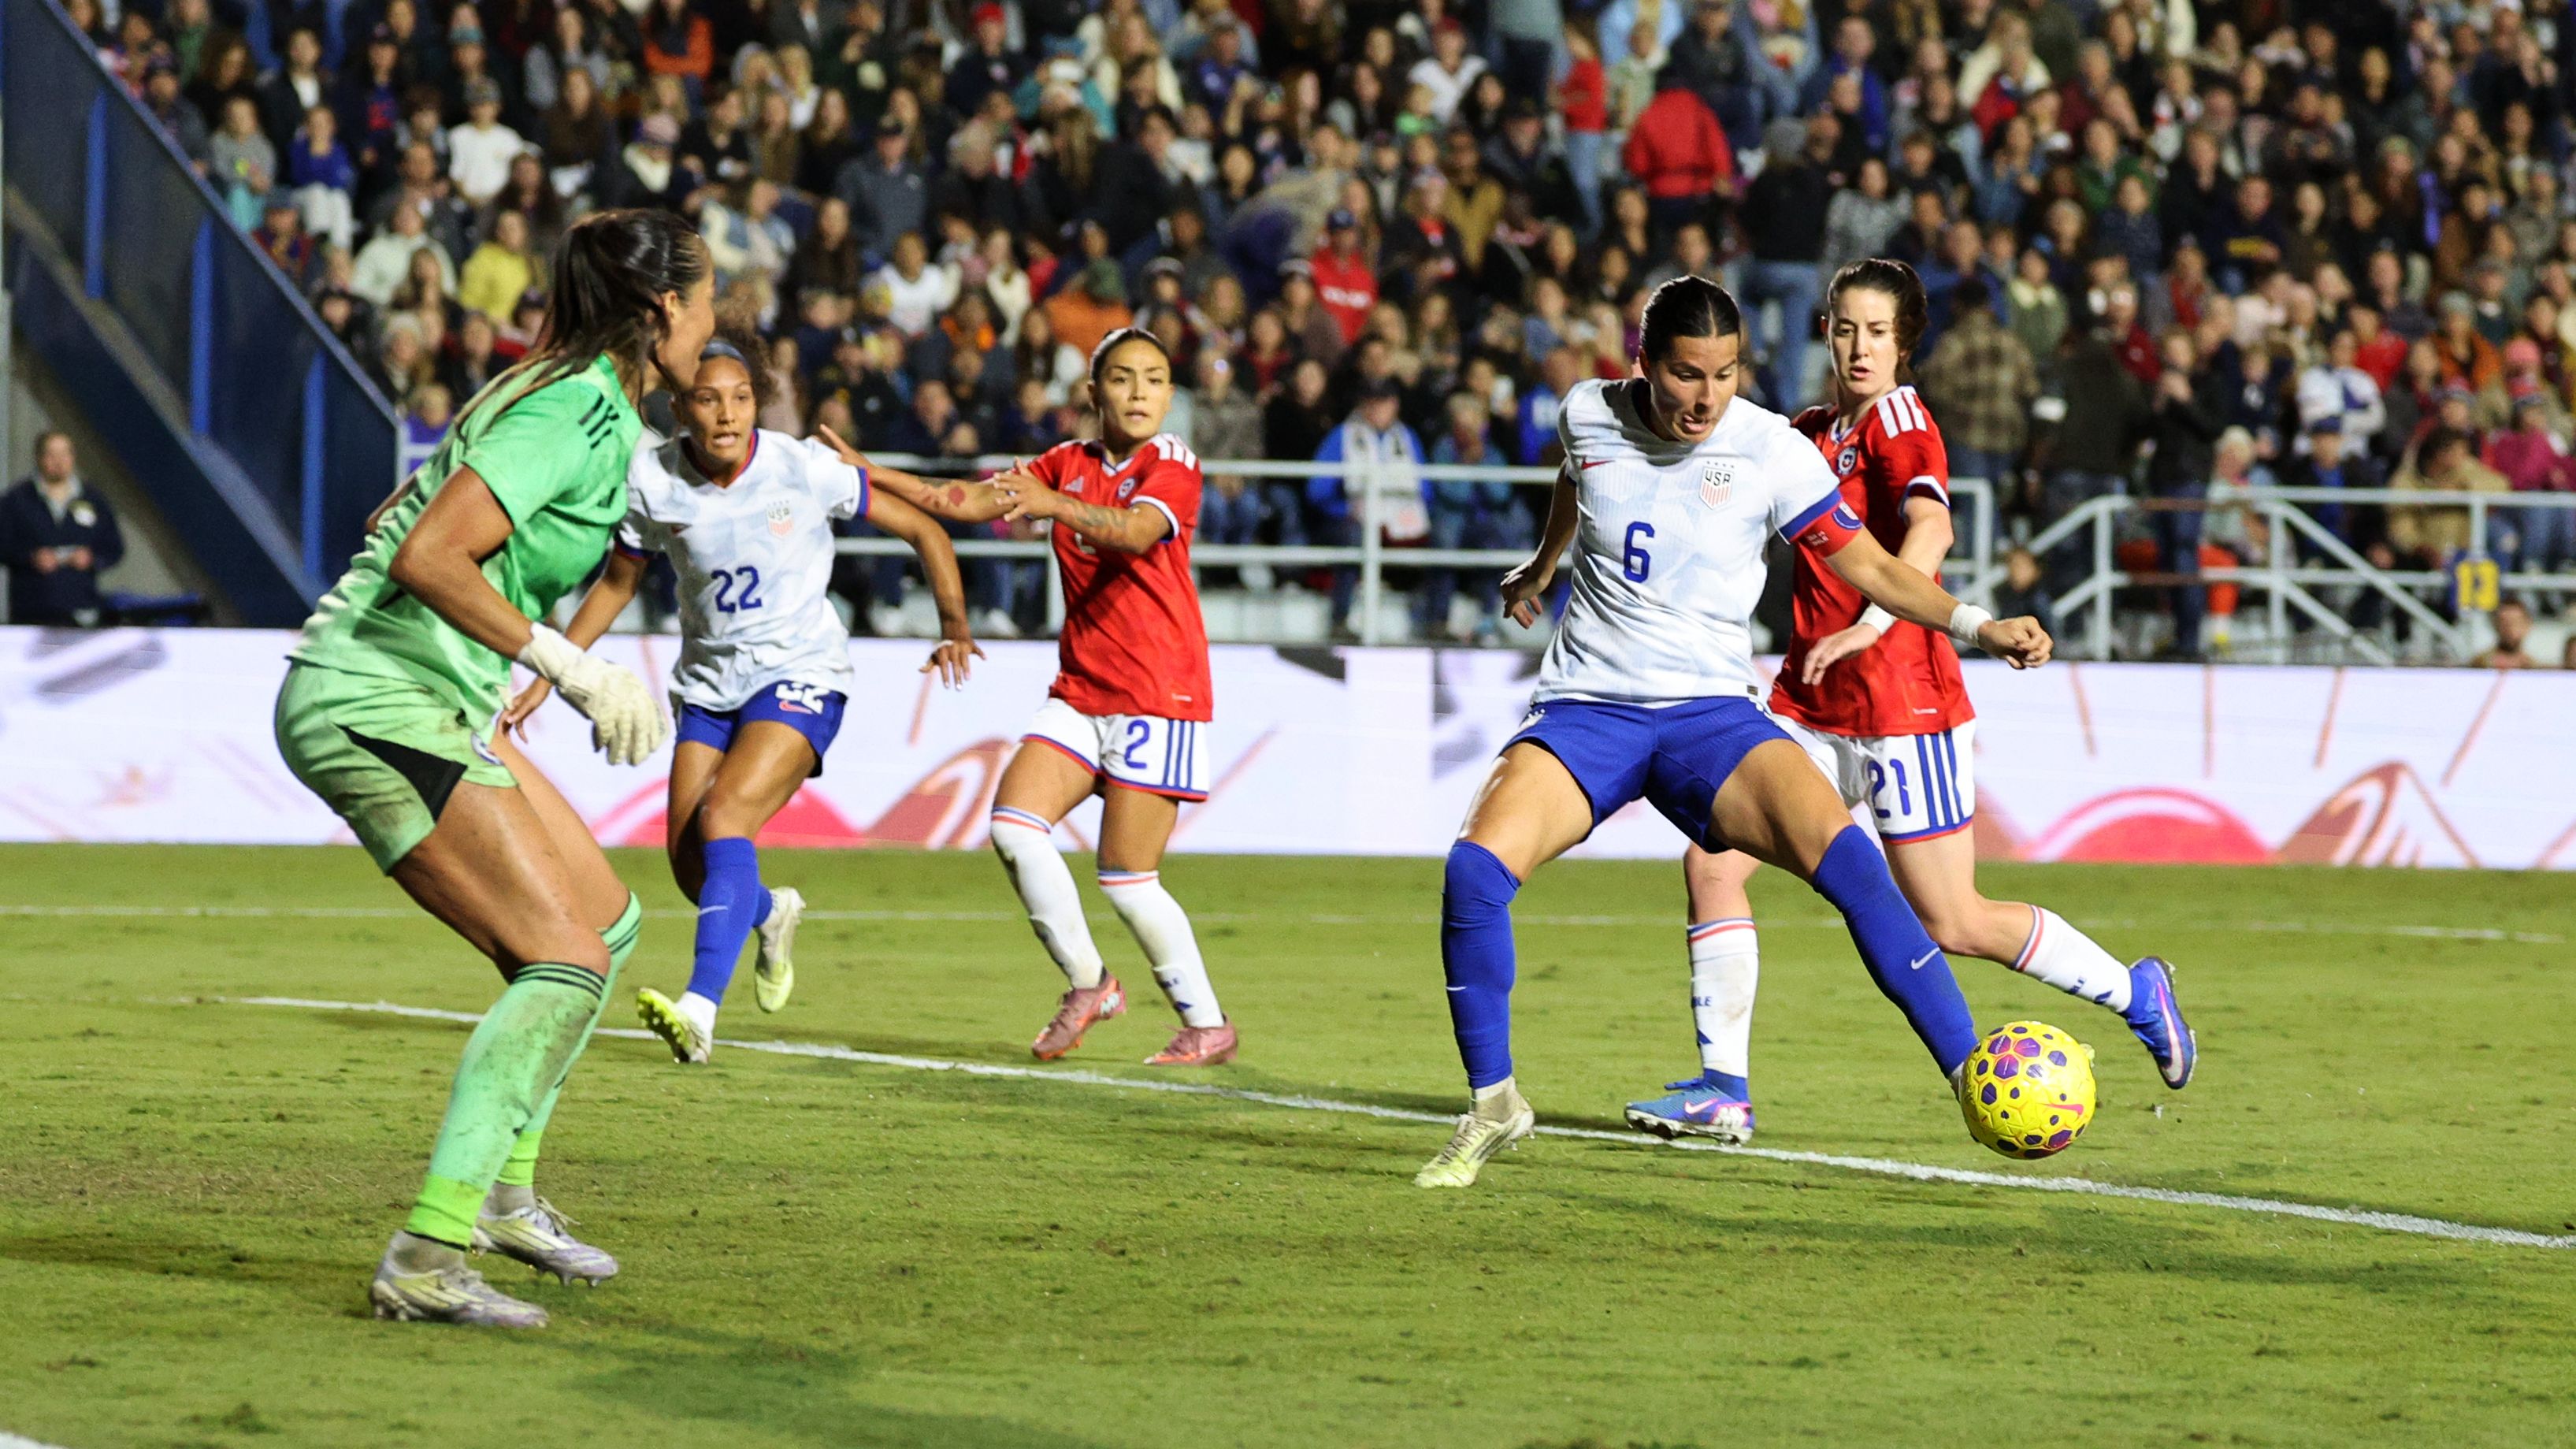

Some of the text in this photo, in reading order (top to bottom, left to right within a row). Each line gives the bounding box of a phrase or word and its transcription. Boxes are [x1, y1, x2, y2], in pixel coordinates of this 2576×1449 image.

[1705, 470, 1732, 486] USA
[768, 507, 790, 521] USA
[1624, 521, 1655, 584] 6
[711, 565, 763, 614] 22
[1124, 719, 1151, 769] 2
[1867, 759, 1912, 819] 21
